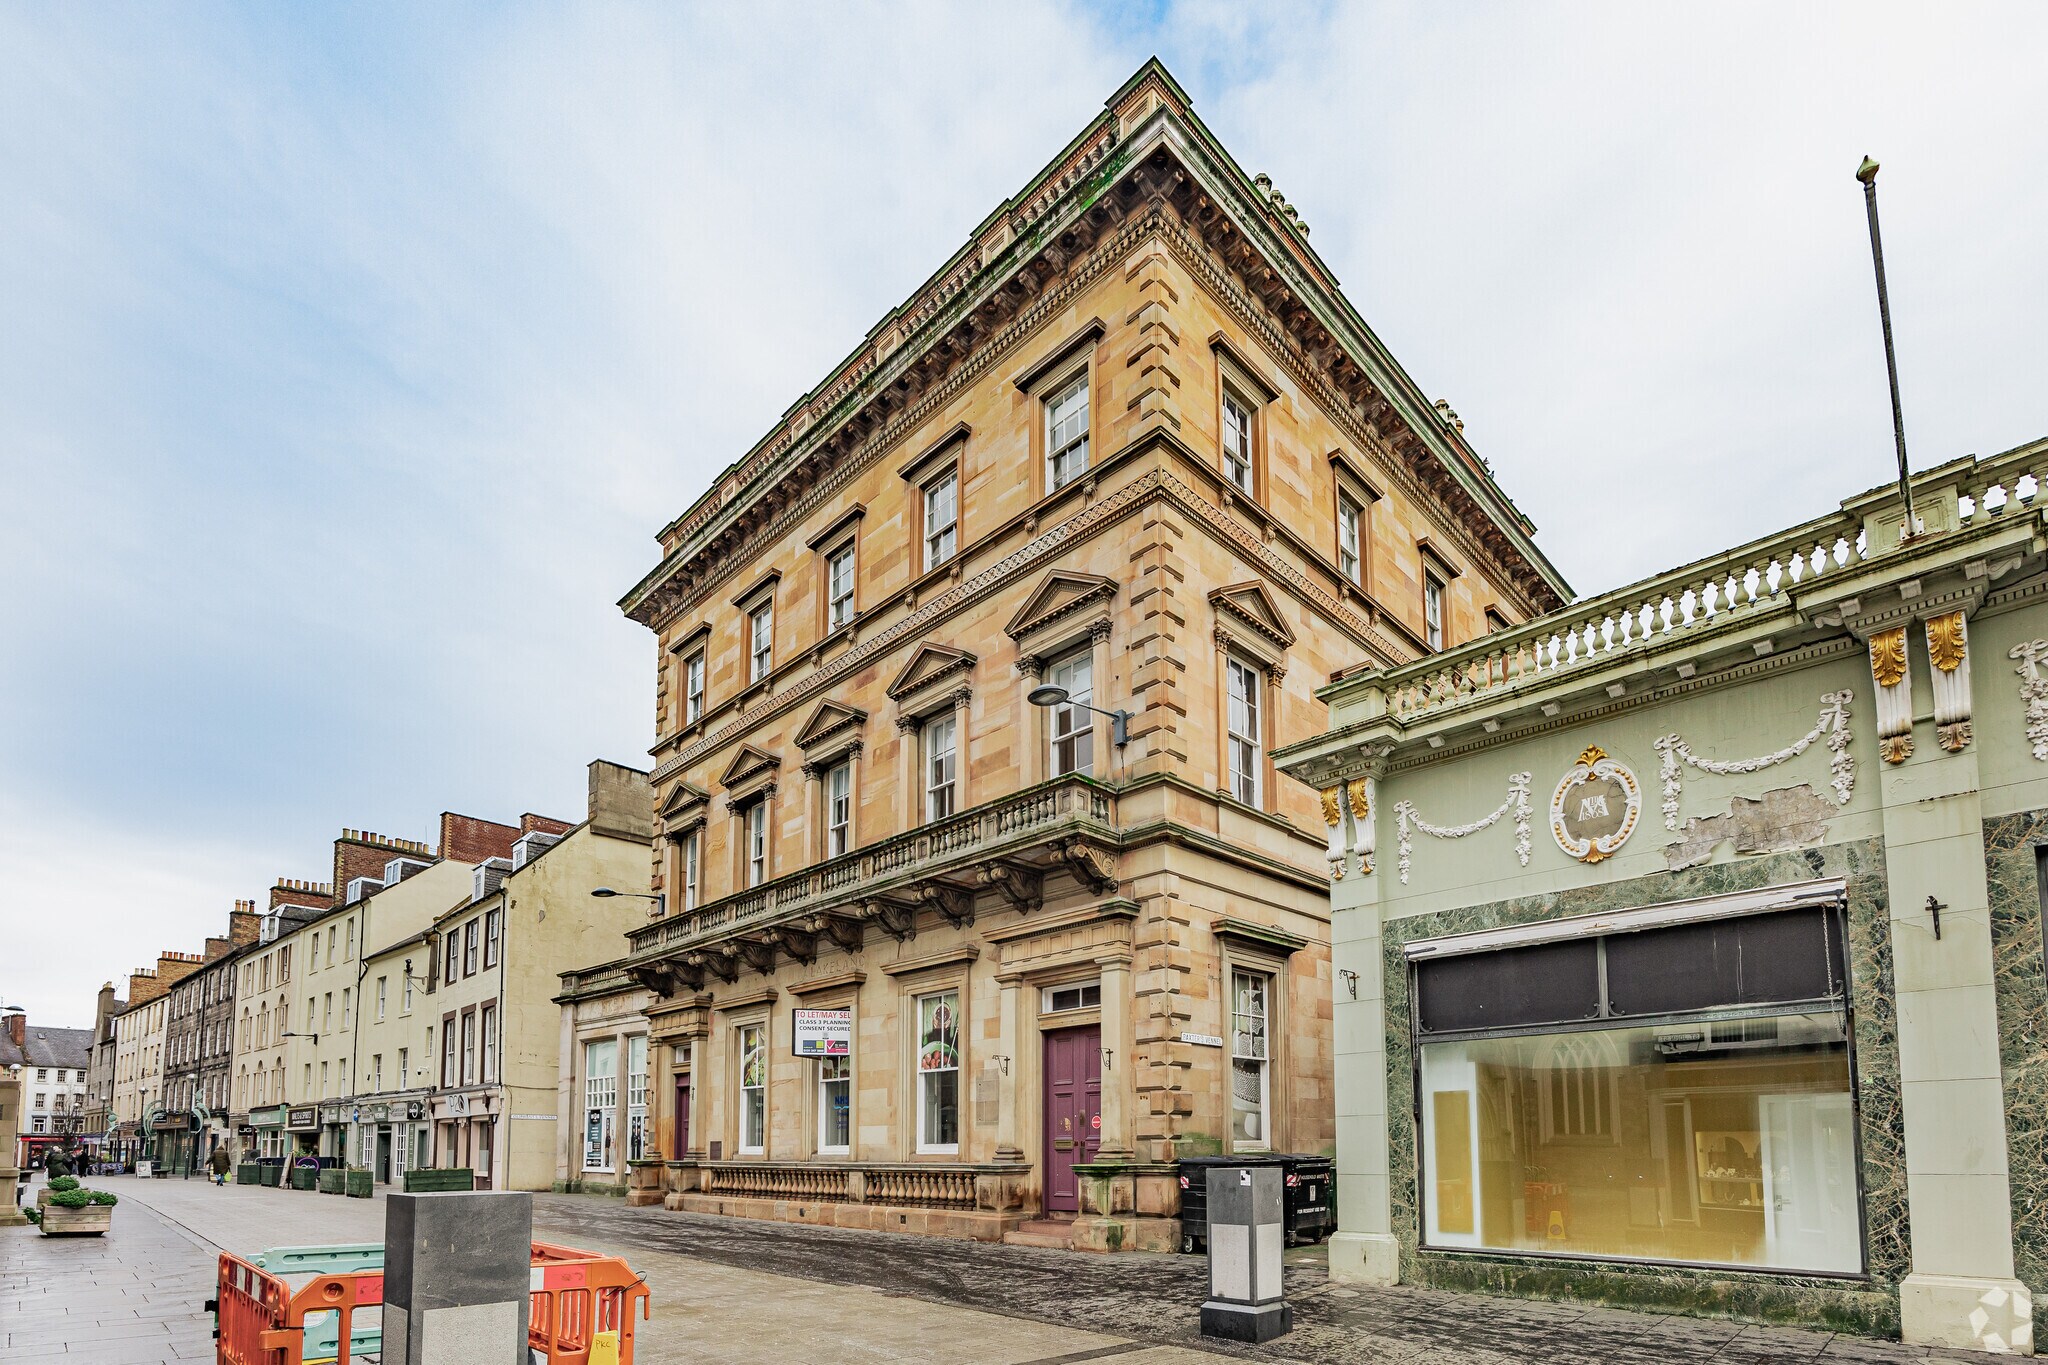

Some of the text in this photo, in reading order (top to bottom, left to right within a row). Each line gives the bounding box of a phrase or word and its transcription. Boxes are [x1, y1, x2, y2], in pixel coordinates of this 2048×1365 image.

[807, 1011, 837, 1019] LET/MAY
[1205, 1036, 1222, 1046] VENNEL
[834, 1095, 849, 1105] NHS
